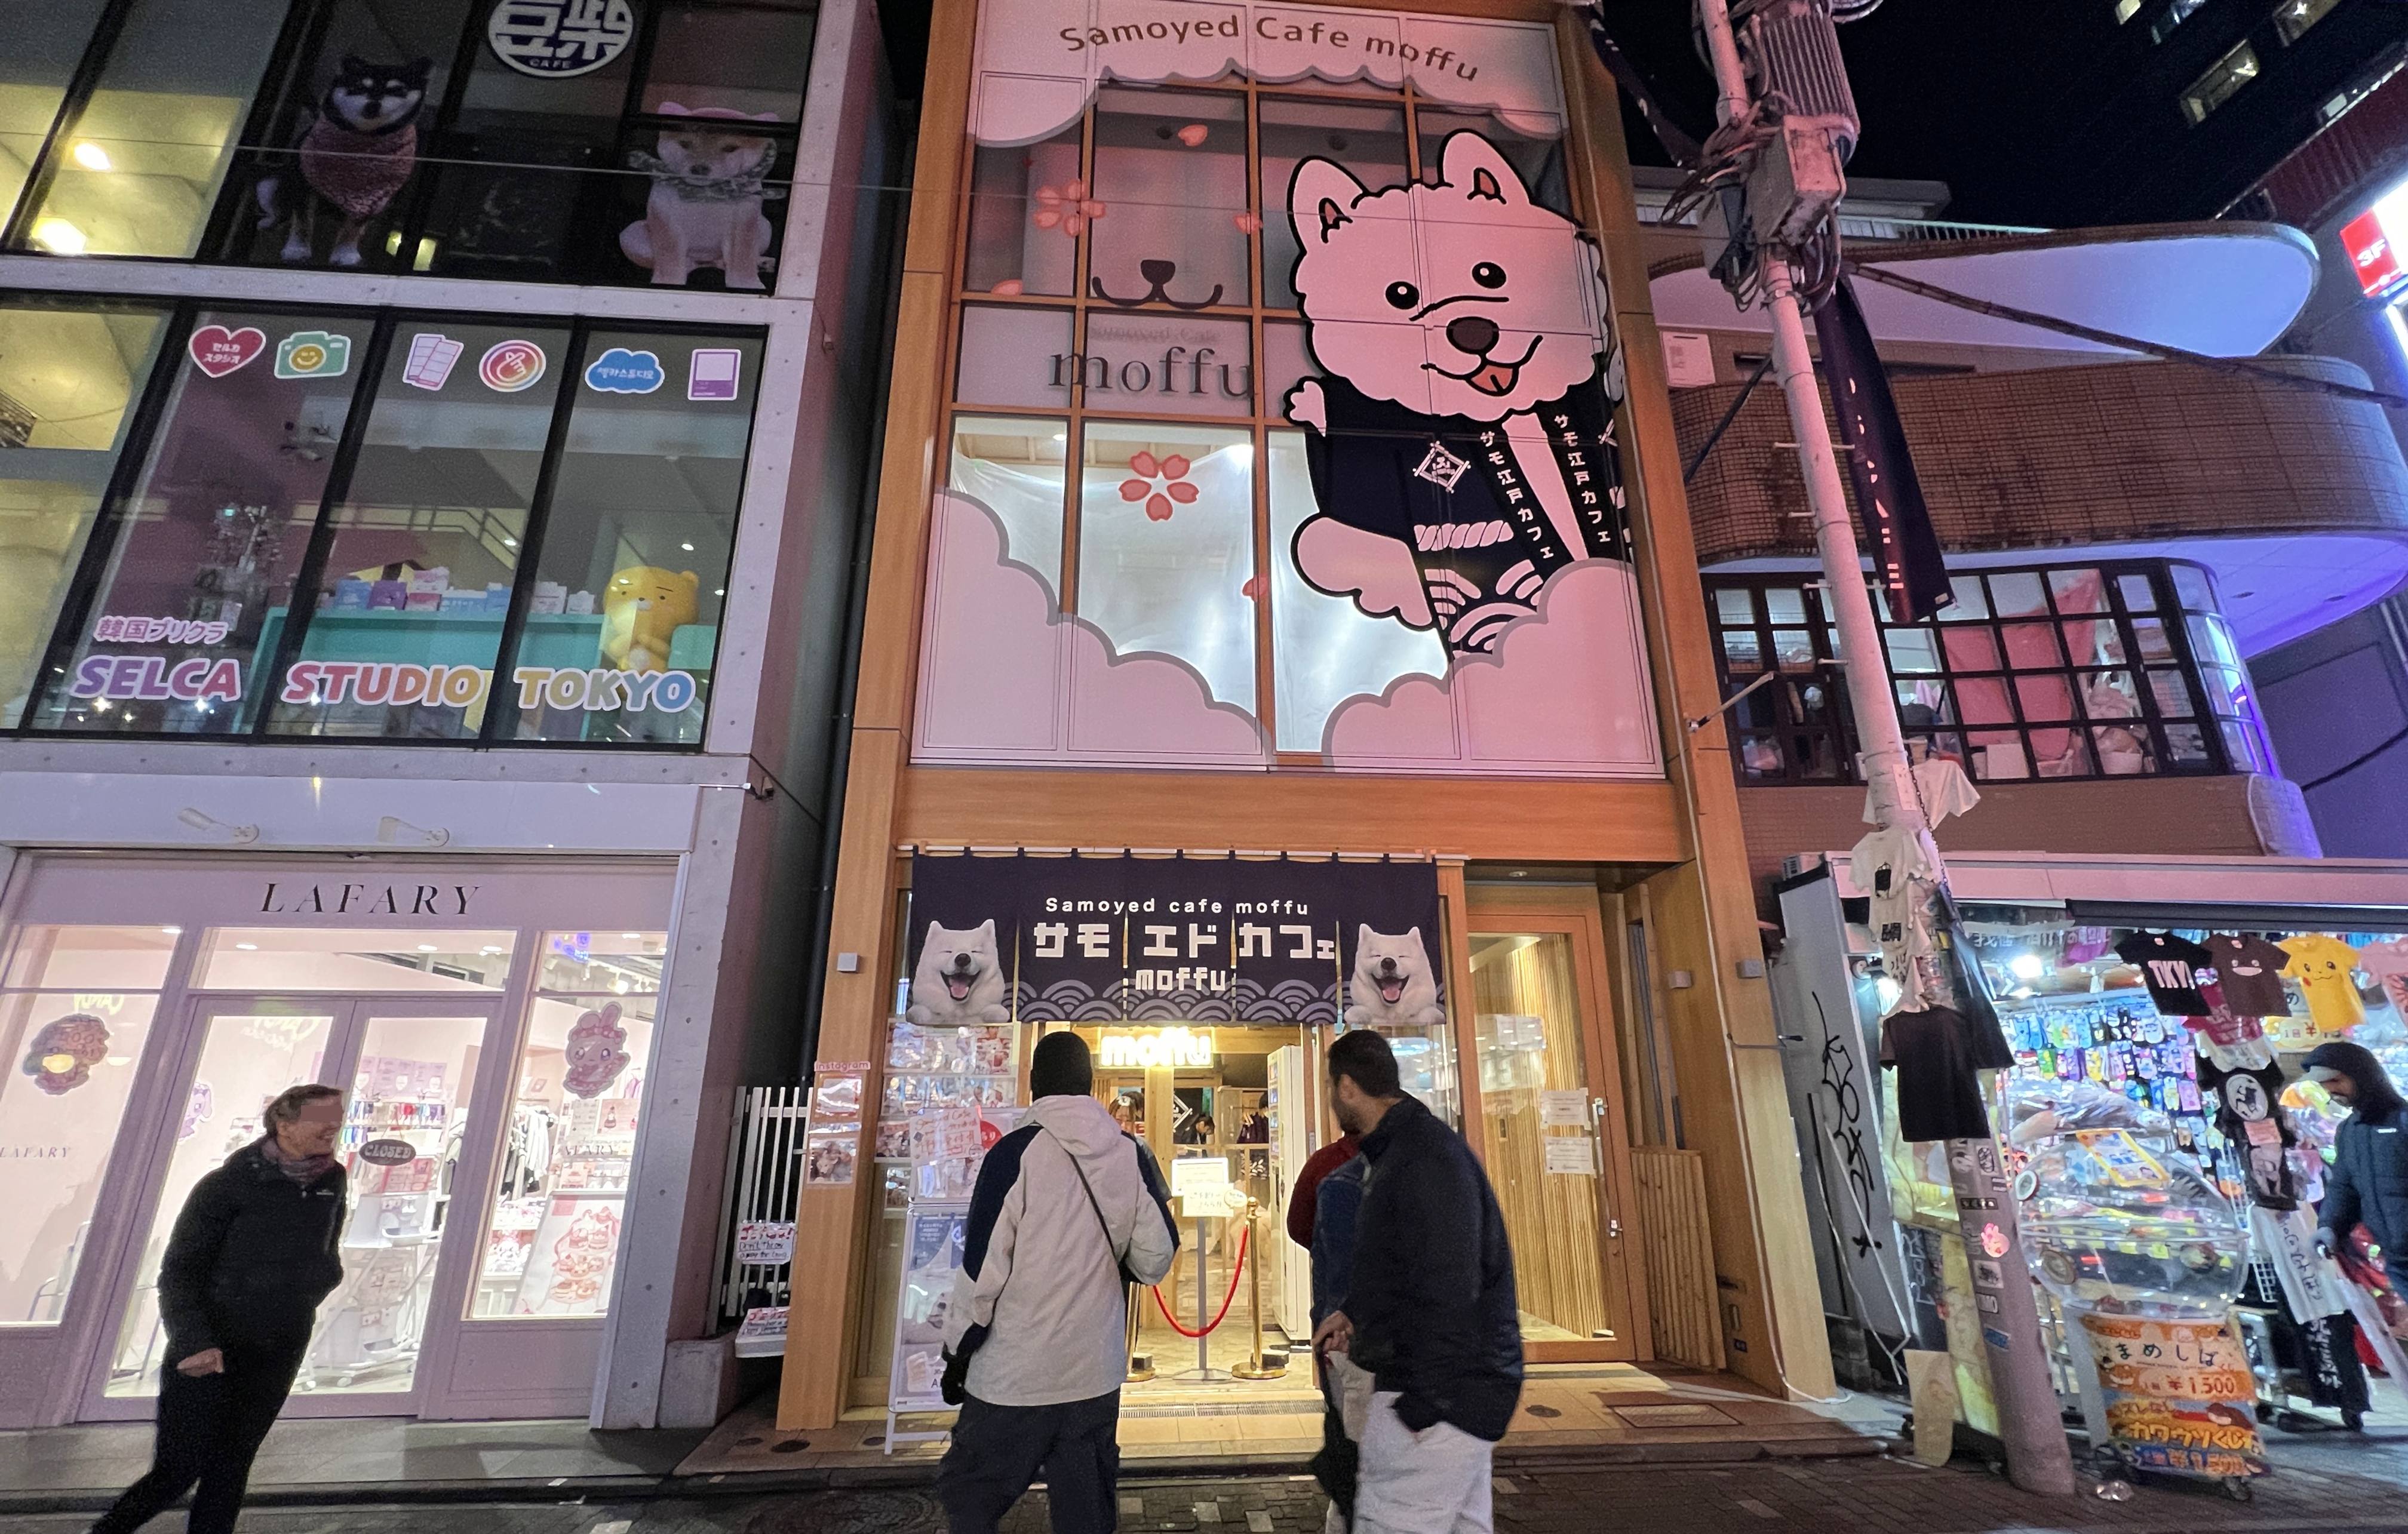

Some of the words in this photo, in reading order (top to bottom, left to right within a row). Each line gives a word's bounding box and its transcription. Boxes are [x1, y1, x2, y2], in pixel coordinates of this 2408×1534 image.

[1059, 15, 1240, 51] Samoyed
[1256, 17, 1350, 48] Cafe
[1365, 36, 1479, 82] moffu
[529, 59, 571, 69] CAFE
[203, 353, 241, 364] スタジオ
[213, 342, 240, 353] セルカ
[1049, 346, 1258, 398] moffu
[1555, 414, 1611, 543] サモ江戸カフェ
[1480, 430, 1555, 560] サモ江戸カフェ
[94, 616, 229, 644] 韓国プリクラ
[70, 656, 241, 702] SELCA
[281, 661, 485, 708] STUDIO
[513, 666, 696, 713] TOKYO
[259, 882, 484, 915] LAFARY
[1045, 897, 1155, 915] Samoyed
[1169, 899, 1223, 914] cafe
[1236, 900, 1309, 915] moffu
[1135, 966, 1226, 991] moffu
[816, 1061, 869, 1071] instagram
[364, 1143, 412, 1160] CLOSED
[2116, 1343, 2218, 1367] まめしば
